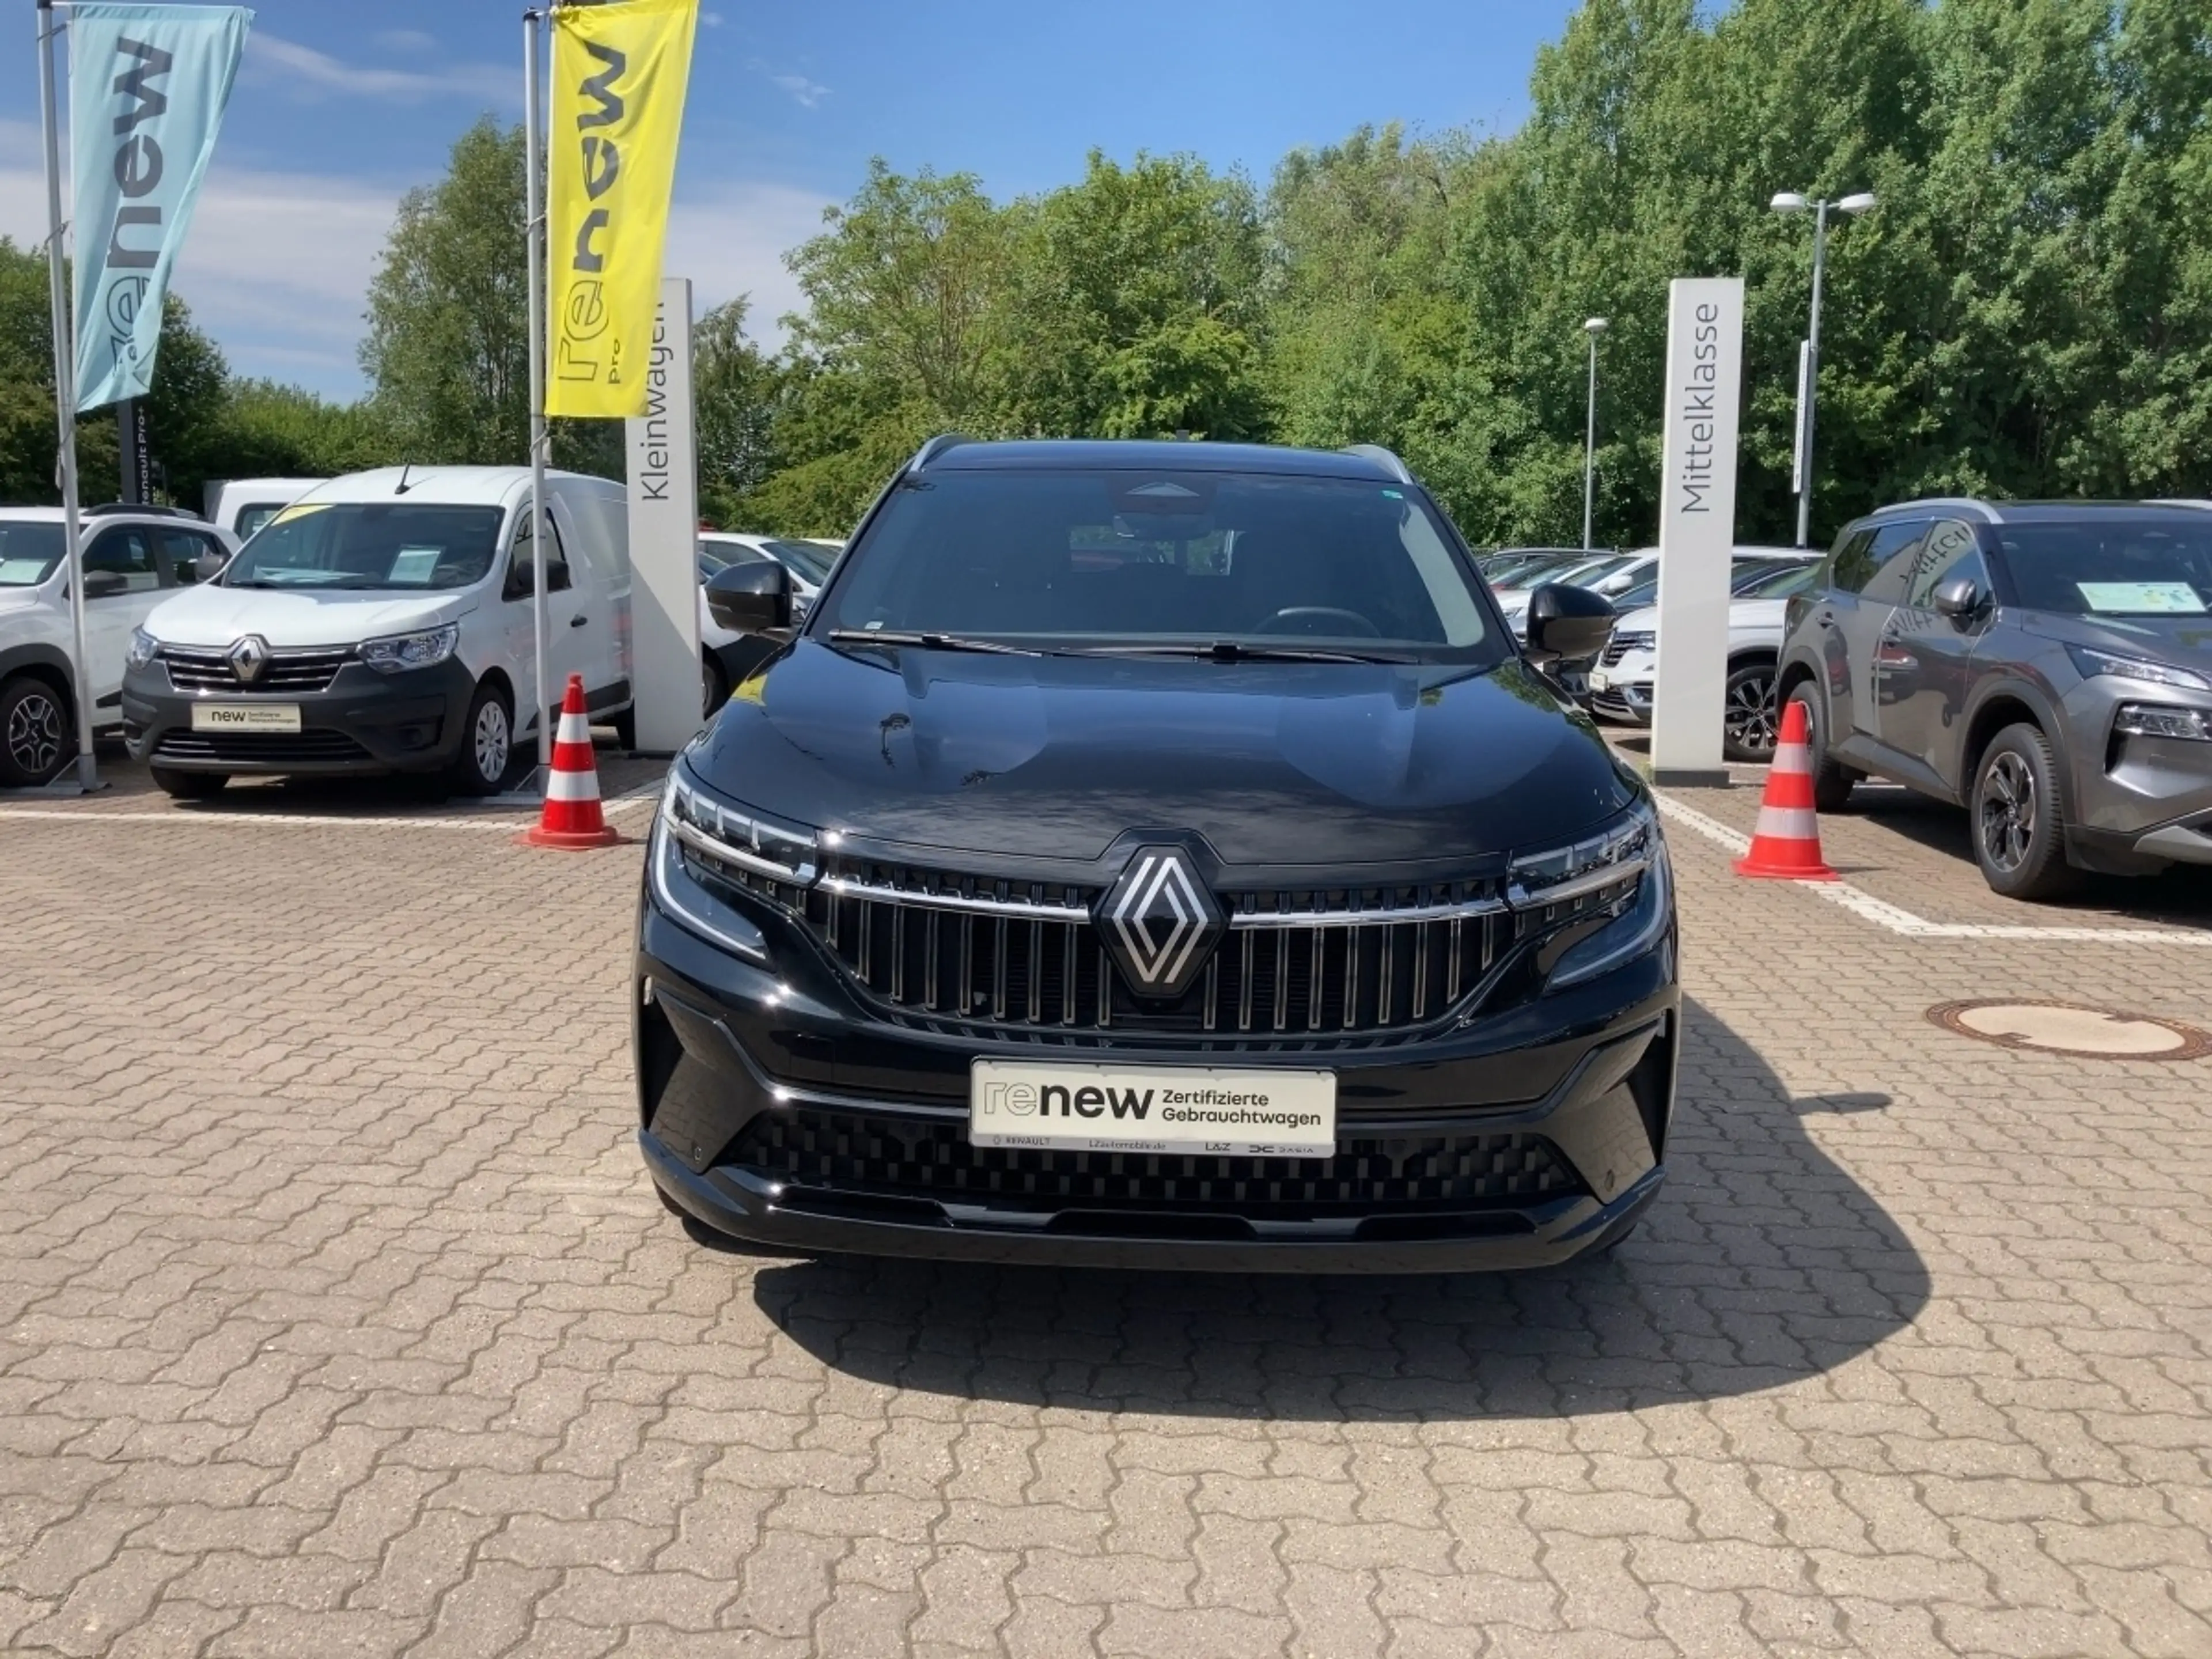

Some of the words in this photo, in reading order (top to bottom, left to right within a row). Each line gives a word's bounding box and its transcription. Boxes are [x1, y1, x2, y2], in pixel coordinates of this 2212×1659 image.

[558, 39, 626, 381] renew
[607, 338, 622, 384] pro
[1681, 303, 1719, 513] Mittelklasse
[984, 1081, 1155, 1119] renew
[1162, 1089, 1269, 1106] Zertifizierte
[1161, 1107, 1321, 1128] Gebrauchtwagen
[1006, 1136, 1051, 1146] RENAULT
[1205, 1142, 1231, 1152] L&Z
